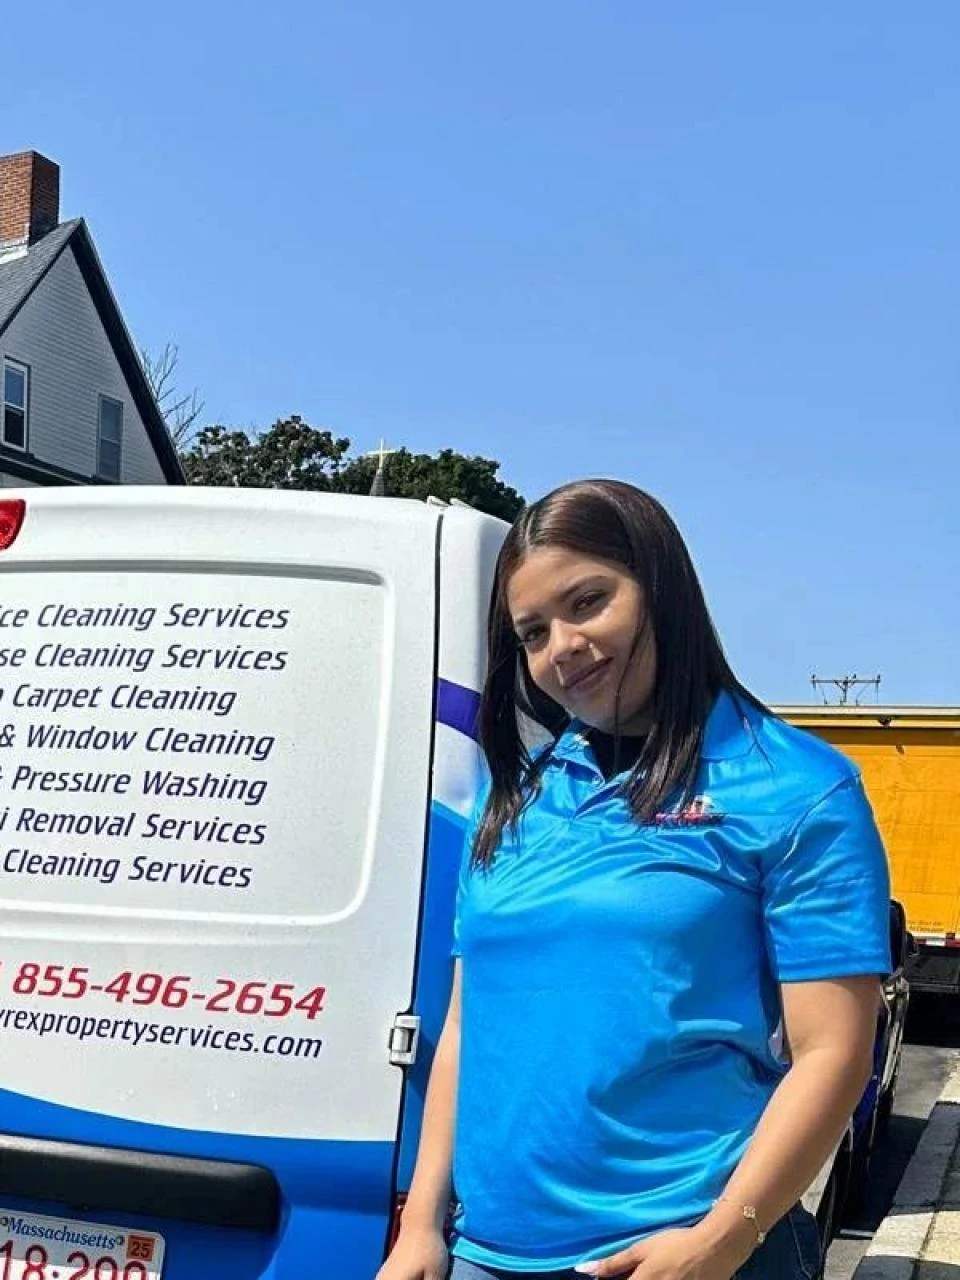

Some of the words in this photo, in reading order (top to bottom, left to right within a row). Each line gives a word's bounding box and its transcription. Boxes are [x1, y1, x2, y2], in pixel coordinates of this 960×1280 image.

[37, 603, 155, 631] Cleaning
[164, 603, 290, 629] Services
[34, 643, 154, 672] Cleaning
[161, 644, 289, 670] Services
[12, 684, 102, 712] Carpet
[110, 684, 237, 716] Cleaning
[26, 725, 137, 752] Window
[145, 727, 275, 761] Cleaning
[11, 765, 131, 794] Pressure
[142, 770, 268, 805] Washing
[16, 807, 135, 837] Removal
[142, 813, 267, 845] Services
[3, 849, 120, 883] Cleaning
[128, 856, 252, 888] Services
[12, 962, 326, 1020] 855-496-2654
[7, 1217, 116, 1249] Massachusetts
[132, 1241, 149, 1258] 25
